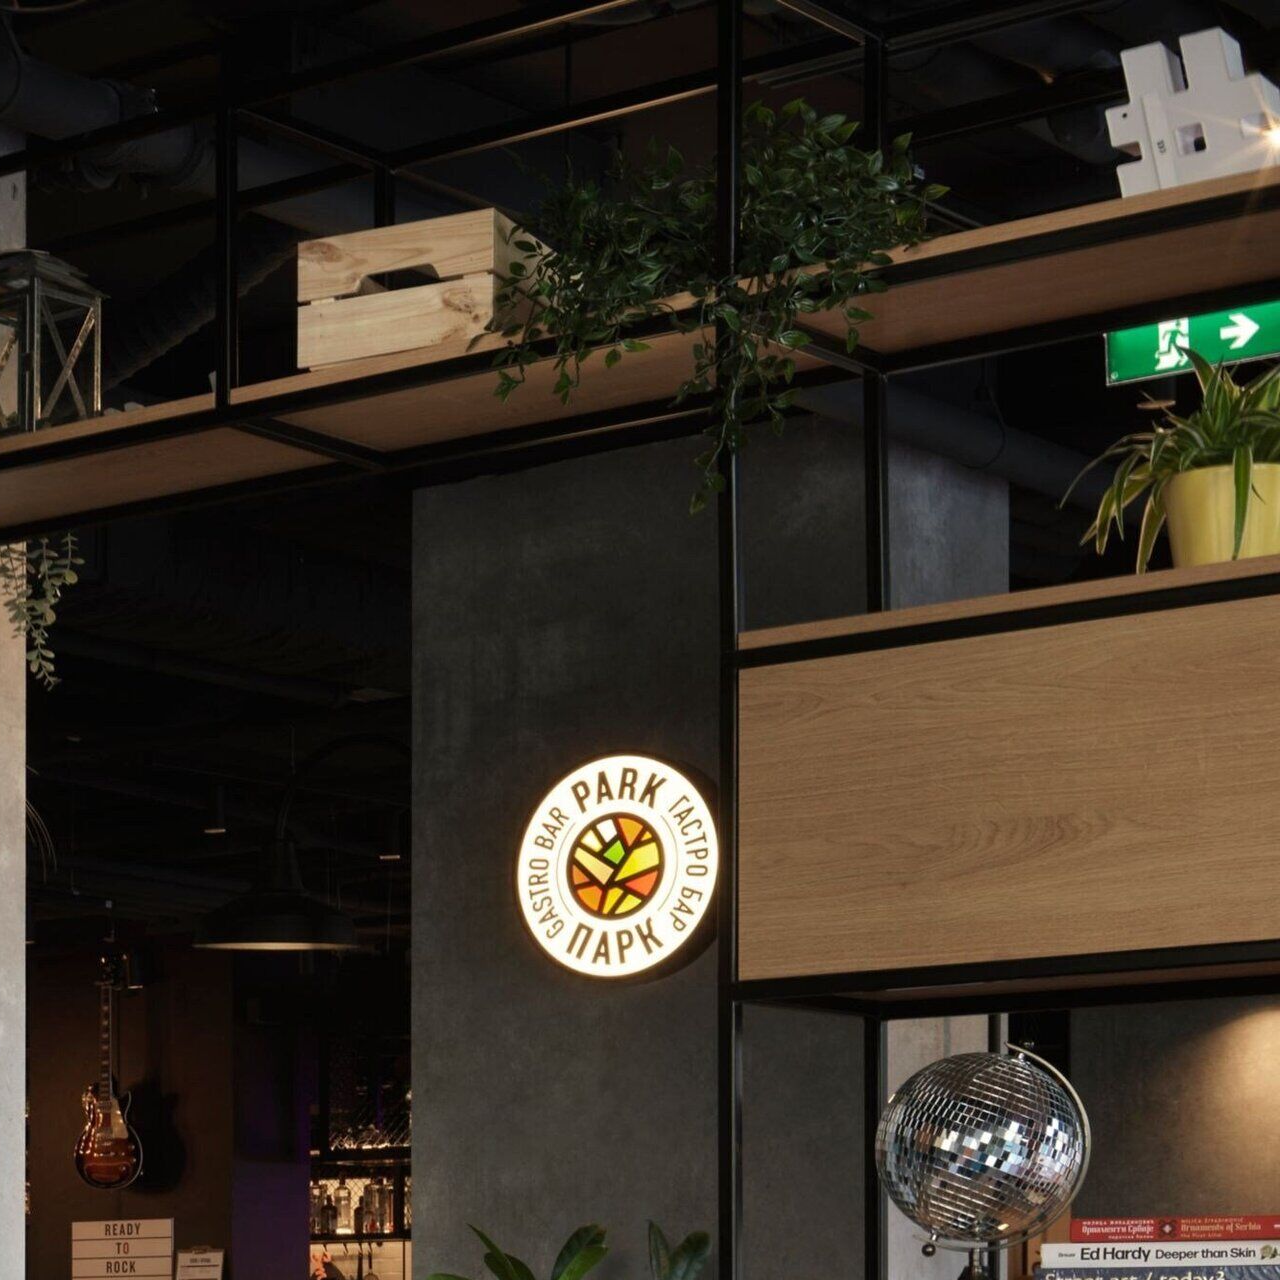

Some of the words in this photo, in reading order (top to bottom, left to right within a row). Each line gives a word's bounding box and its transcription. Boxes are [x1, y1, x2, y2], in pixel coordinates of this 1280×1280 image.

[570, 767, 668, 815] PARK
[534, 805, 571, 851] BAR
[667, 793, 709, 877] ГАСТРО
[527, 858, 566, 940] GASTRO
[672, 886, 704, 933] БАР
[565, 916, 665, 966] ПАРК
[104, 1222, 141, 1236] READY
[115, 1241, 130, 1255] TO
[106, 1260, 137, 1274] ROCK
[1080, 1248, 1099, 1261] Ed
[1102, 1247, 1151, 1263] Hardy
[1155, 1249, 1199, 1261] Deeper
[1201, 1248, 1228, 1258] than
[1230, 1247, 1256, 1258] Skin
